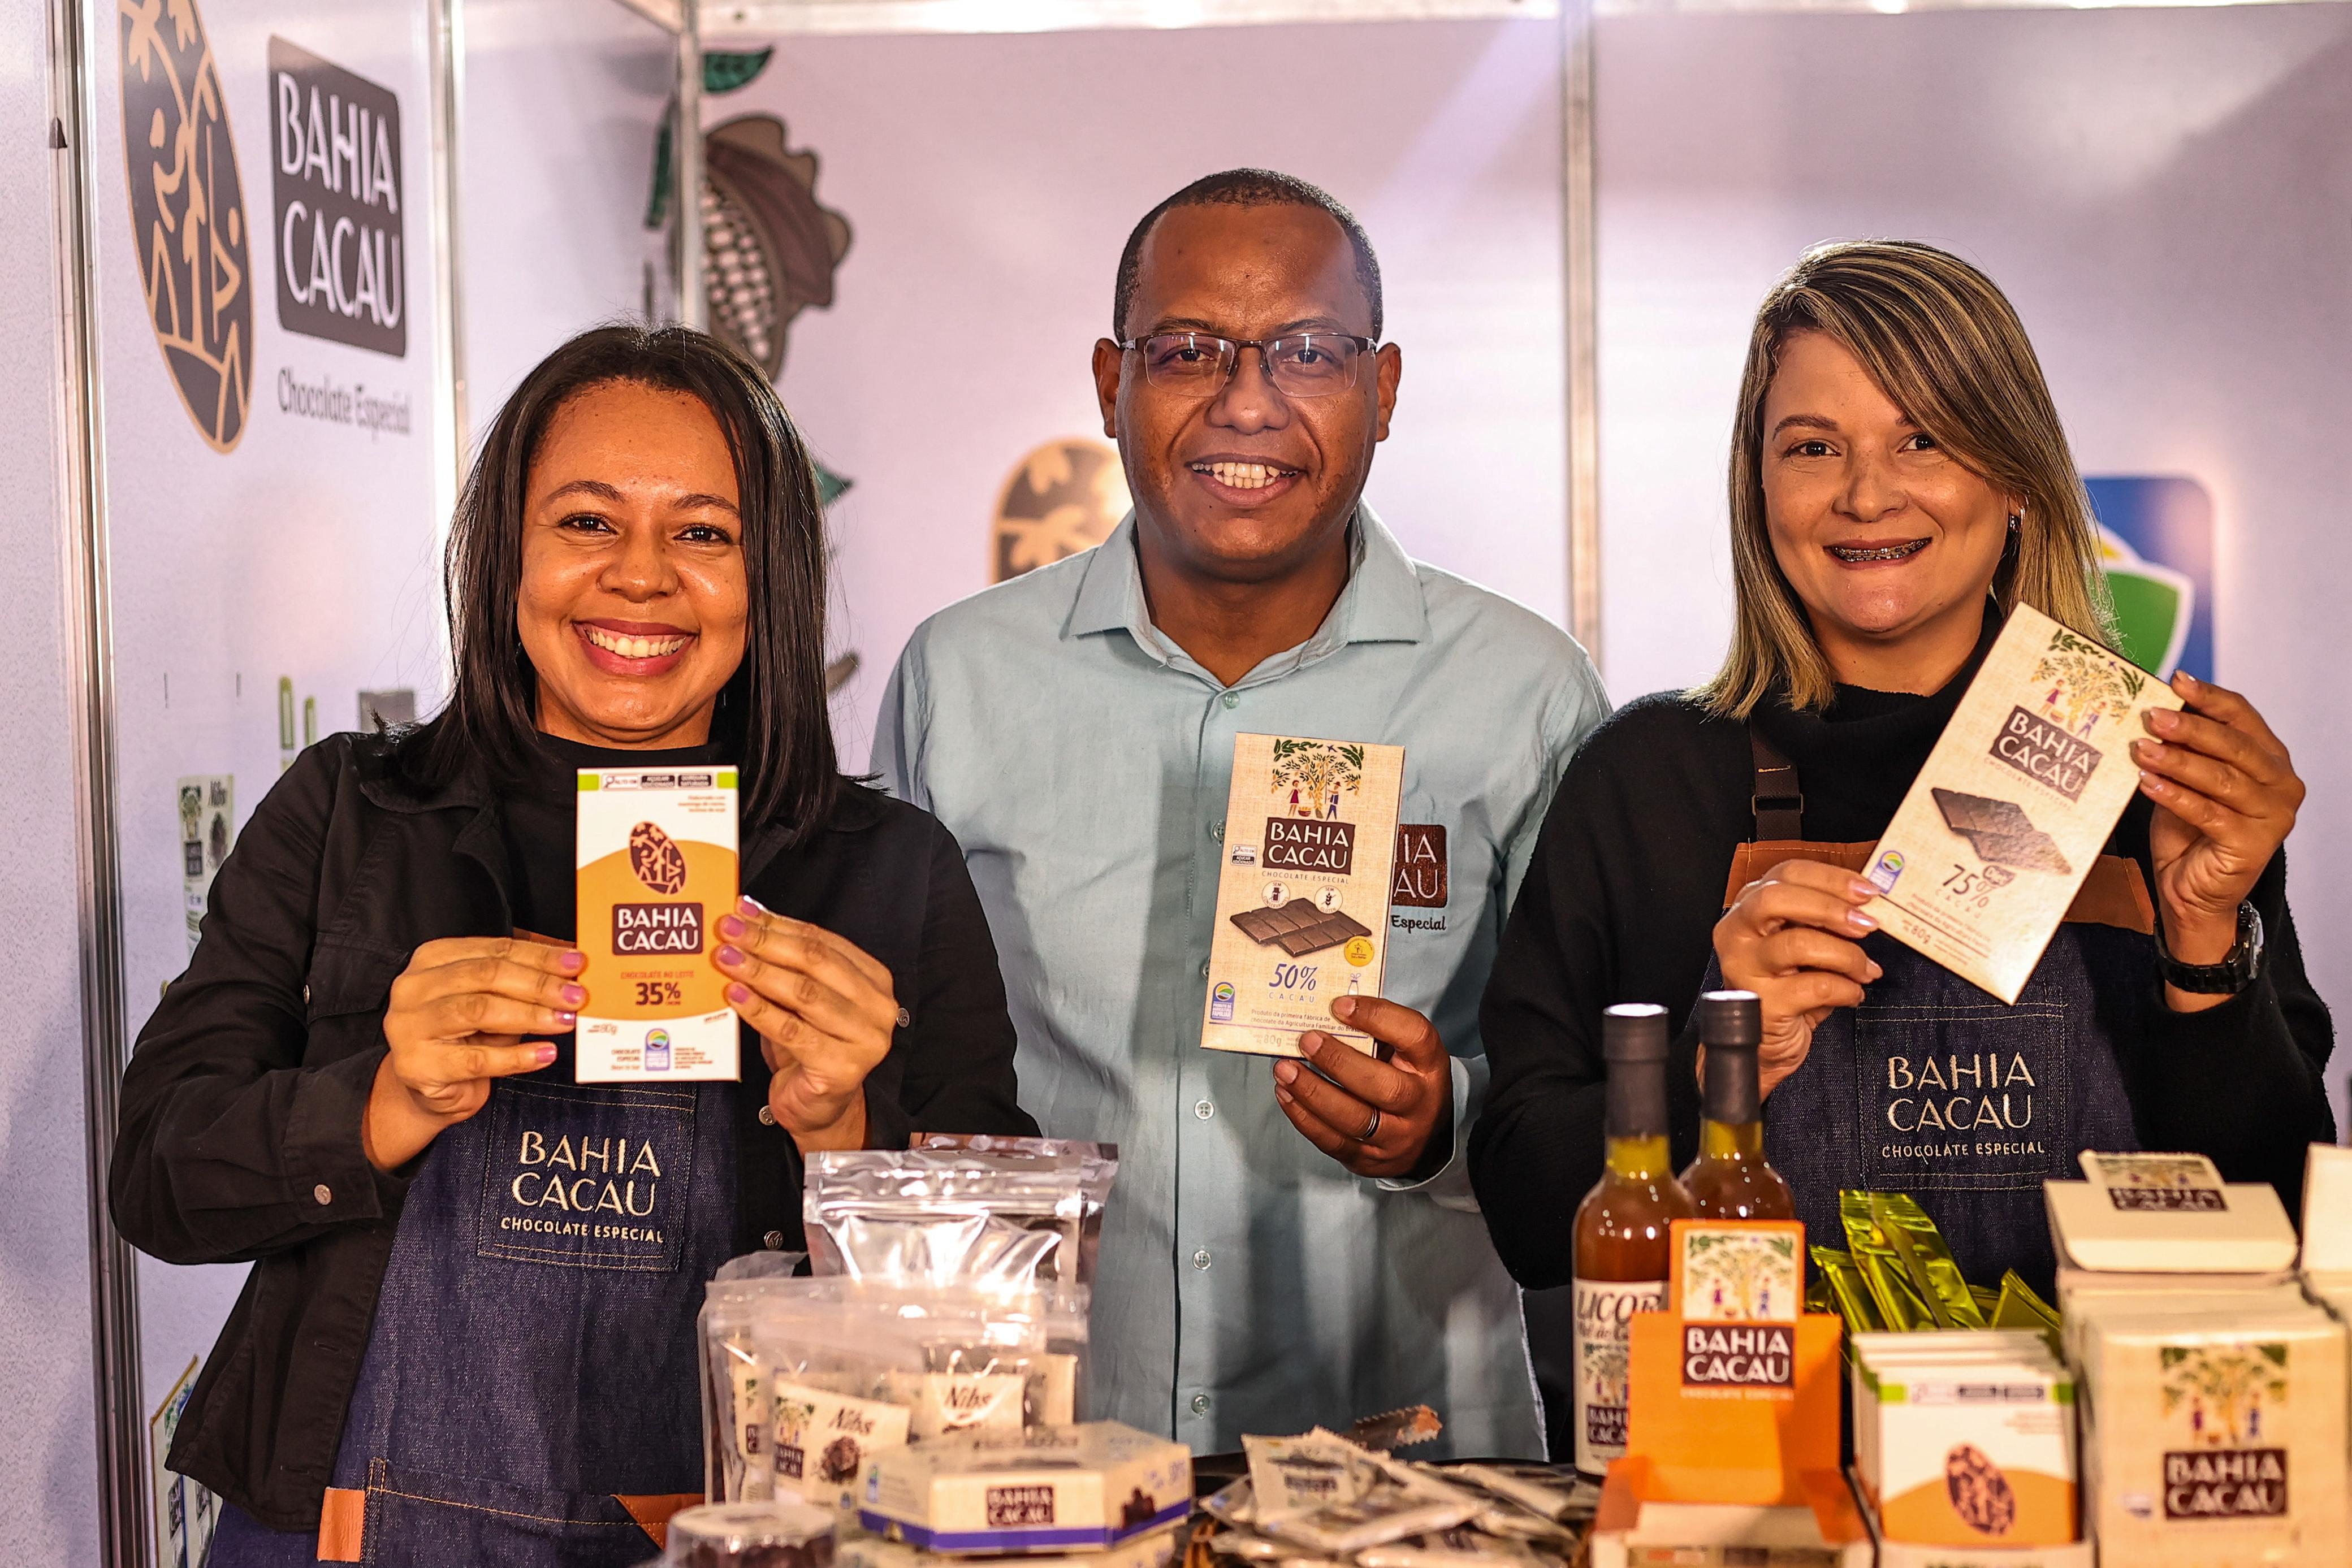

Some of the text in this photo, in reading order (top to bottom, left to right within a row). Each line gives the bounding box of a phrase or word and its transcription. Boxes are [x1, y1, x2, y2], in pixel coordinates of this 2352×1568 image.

[278, 71, 397, 215] BAHIA
[282, 200, 401, 330] CACAU
[278, 366, 351, 425] Chocolate
[2008, 711, 2091, 774] BAHIA
[1999, 735, 2082, 795] CACAU
[1270, 822, 1349, 847] BAHIA
[1268, 844, 1347, 869] CACAU
[1262, 870, 1348, 884] CHOCOLATE ESPECIAL
[1942, 863, 1990, 909] 75%
[617, 907, 697, 928] BAHIA
[1391, 915, 1447, 933] Especial
[617, 930, 699, 951] CACAU
[1269, 963, 1318, 991] 50%
[635, 982, 681, 1006] 35%
[1269, 991, 1315, 1003] CACAU
[1264, 1034, 1282, 1046] 80g
[1888, 1051, 2035, 1091] BAHIA
[1887, 1093, 2031, 1132] CACAU
[518, 1130, 661, 1177] BAHIA
[1882, 1141, 2045, 1158] CHOCOLATE ESPECIAL
[511, 1172, 655, 1217] CACAU
[500, 1217, 664, 1244] CHOCOLATE ESPECIAL
[1687, 1327, 1790, 1355] BAHIA
[1686, 1354, 1789, 1383] CACAU
[944, 1386, 993, 1408] Nibs
[828, 1407, 876, 1436] Nibs
[2168, 1451, 2284, 1485] BAHIA
[2168, 1482, 2285, 1515] CACAU
